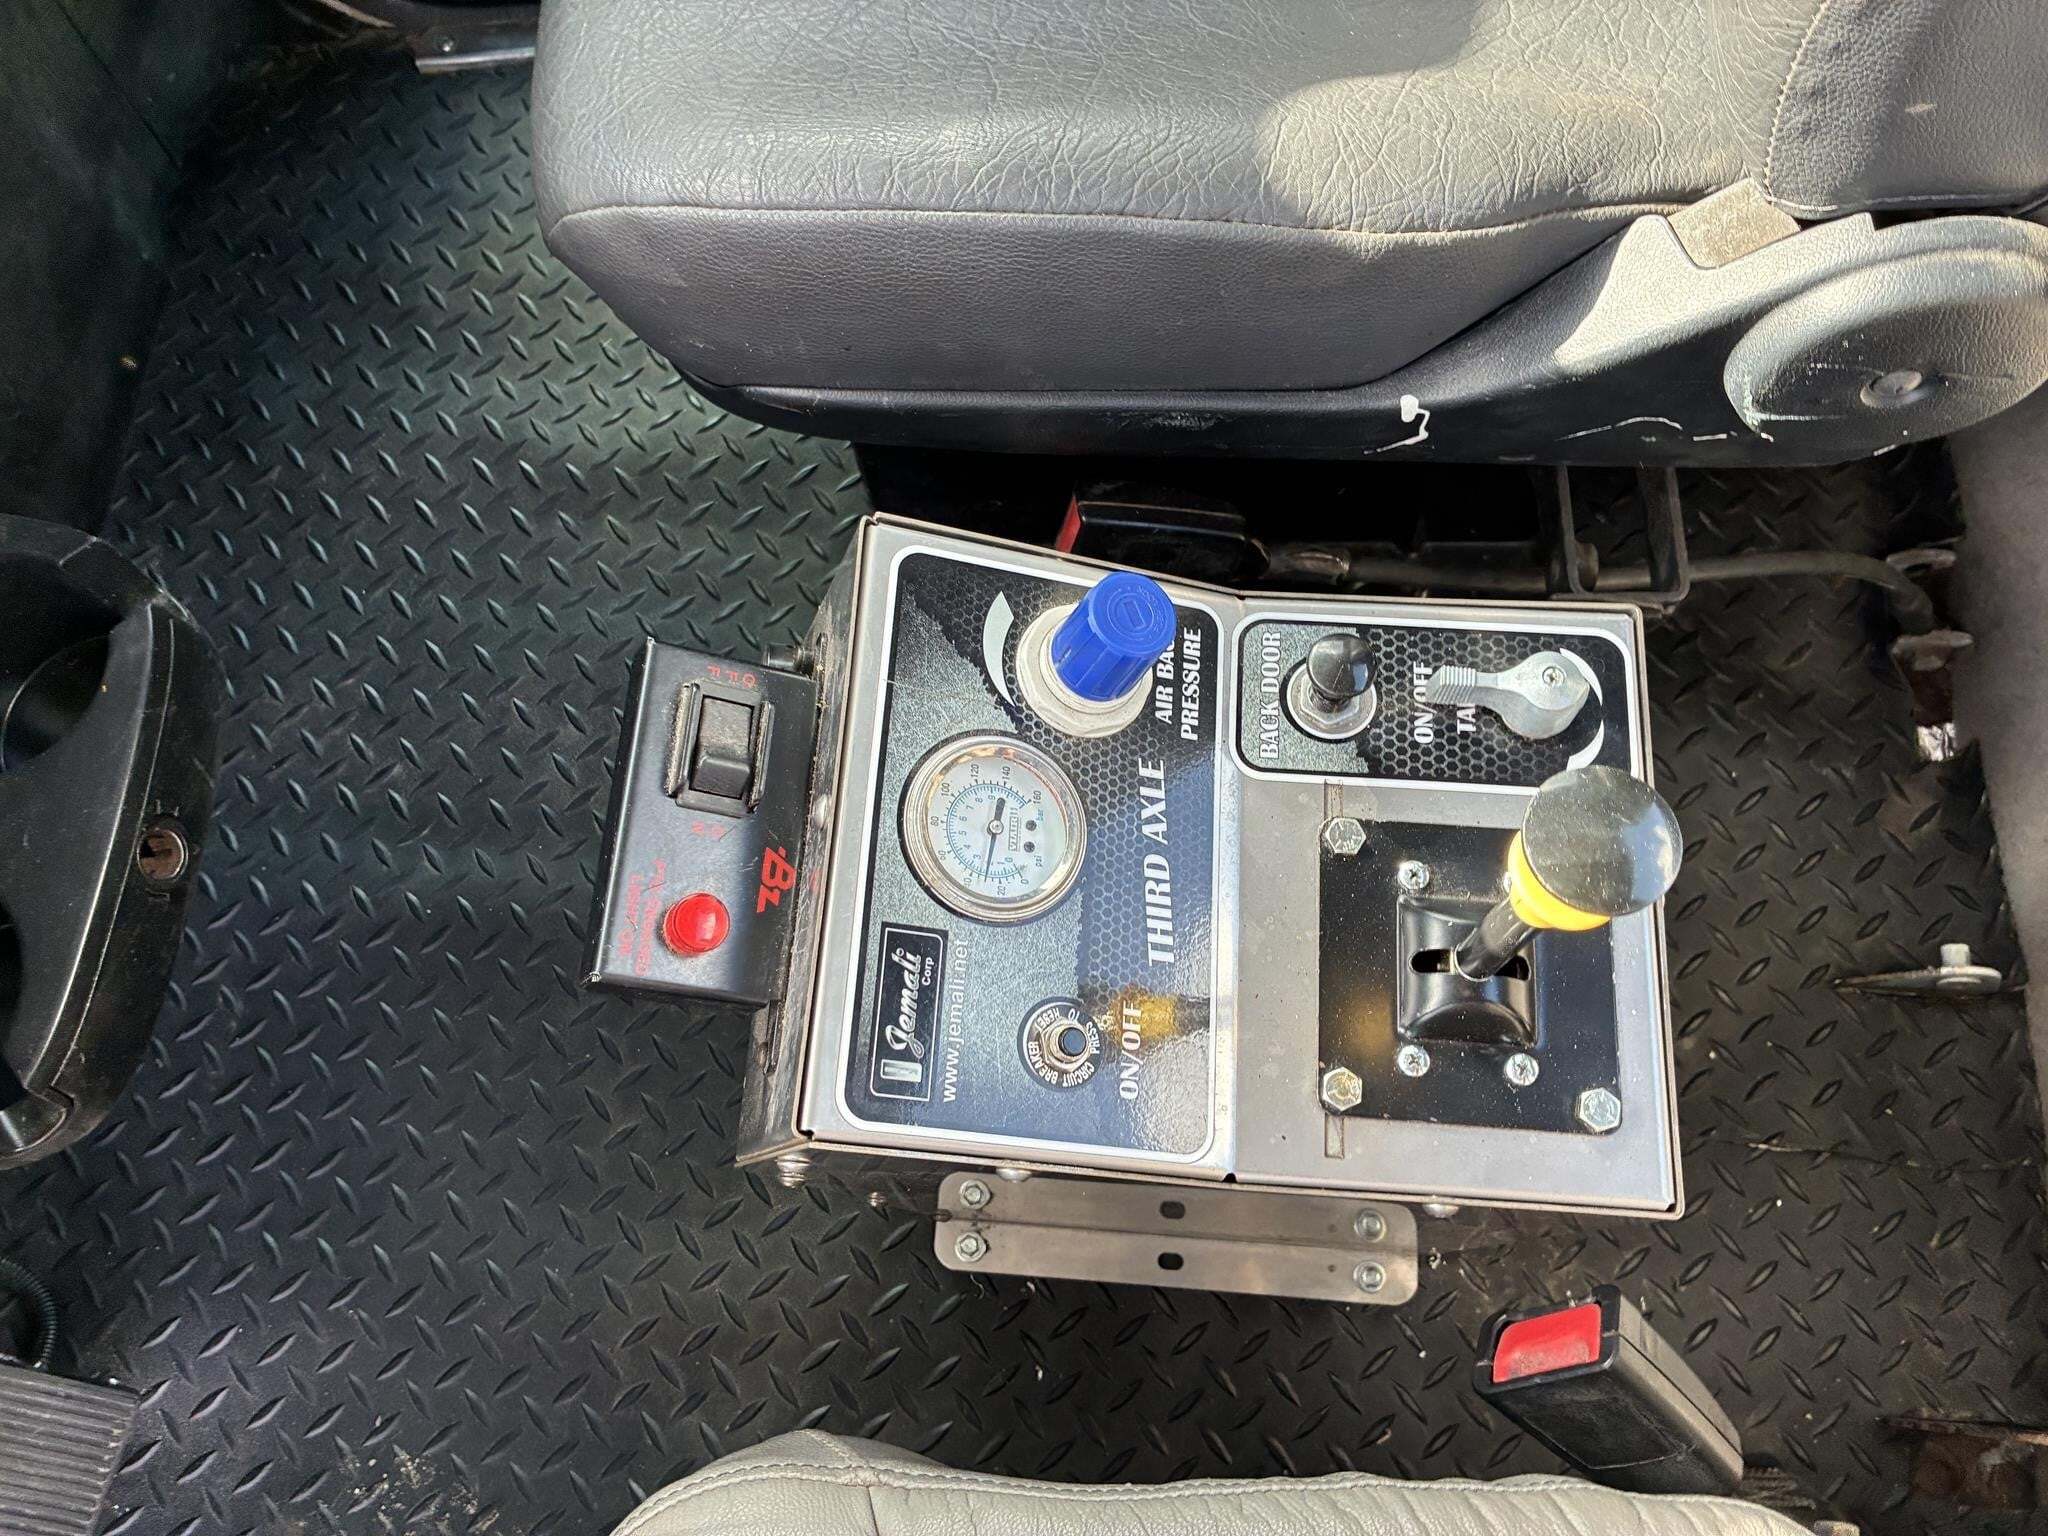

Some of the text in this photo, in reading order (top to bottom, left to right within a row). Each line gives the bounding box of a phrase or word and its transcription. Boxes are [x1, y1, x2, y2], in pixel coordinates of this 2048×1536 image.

[1154, 640, 1175, 724] AIR BA
[1180, 628, 1201, 741] PRESSURE
[1259, 632, 1281, 758] BACK DOOR
[1413, 661, 1437, 744] ON/OFF
[941, 783, 949, 796] 100
[970, 764, 979, 778] 120
[1002, 766, 1010, 780] 140
[1033, 791, 1041, 804] 160
[1035, 808, 1043, 821] bar
[931, 816, 938, 827] 80
[1008, 816, 1018, 851] VIAIR
[1035, 855, 1044, 867] psi
[1138, 758, 1175, 966] THIRD AXLE
[997, 886, 1006, 896] 20
[922, 957, 934, 985] Corp
[885, 948, 924, 1059] Jemali
[942, 938, 968, 1103] www.jemali.net
[1035, 1008, 1100, 1054] PRESS TO RESET
[1119, 1001, 1143, 1099] ON/OFF
[1028, 1041, 1094, 1087] CIRCUIT BREAKER
